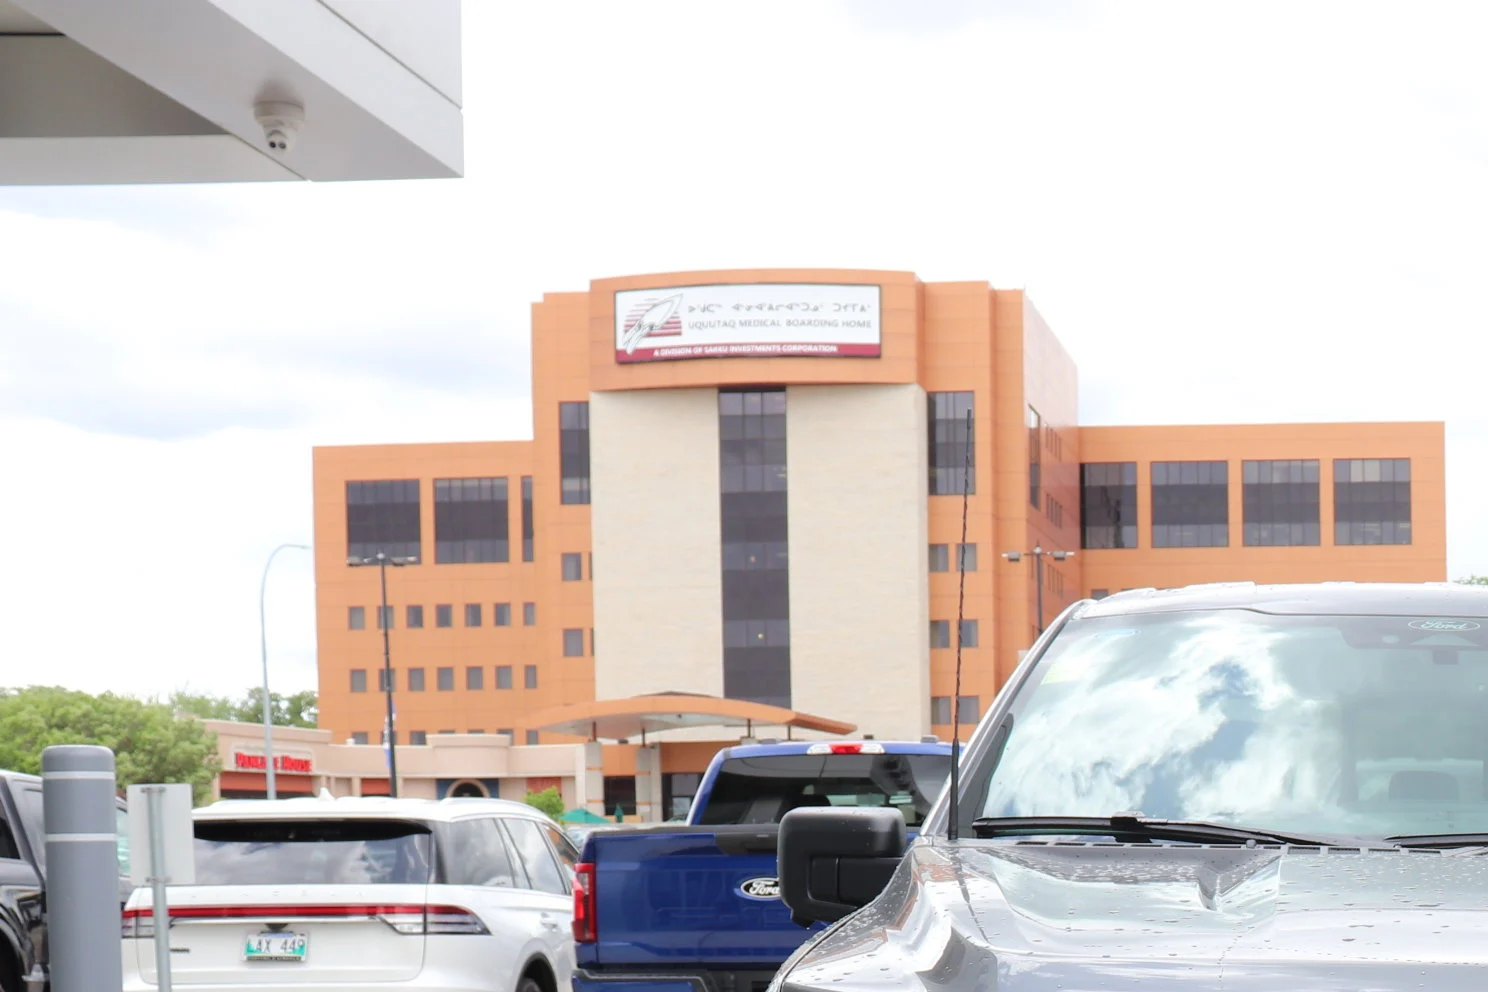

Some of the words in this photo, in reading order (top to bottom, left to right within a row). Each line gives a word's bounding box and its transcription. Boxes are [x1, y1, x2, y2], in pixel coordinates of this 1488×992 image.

[739, 319, 780, 328] MEDICAL
[786, 319, 839, 328] BOARDING
[841, 320, 872, 329] HOME
[1420, 621, 1468, 630] Ford
[236, 752, 280, 770] PANCAE
